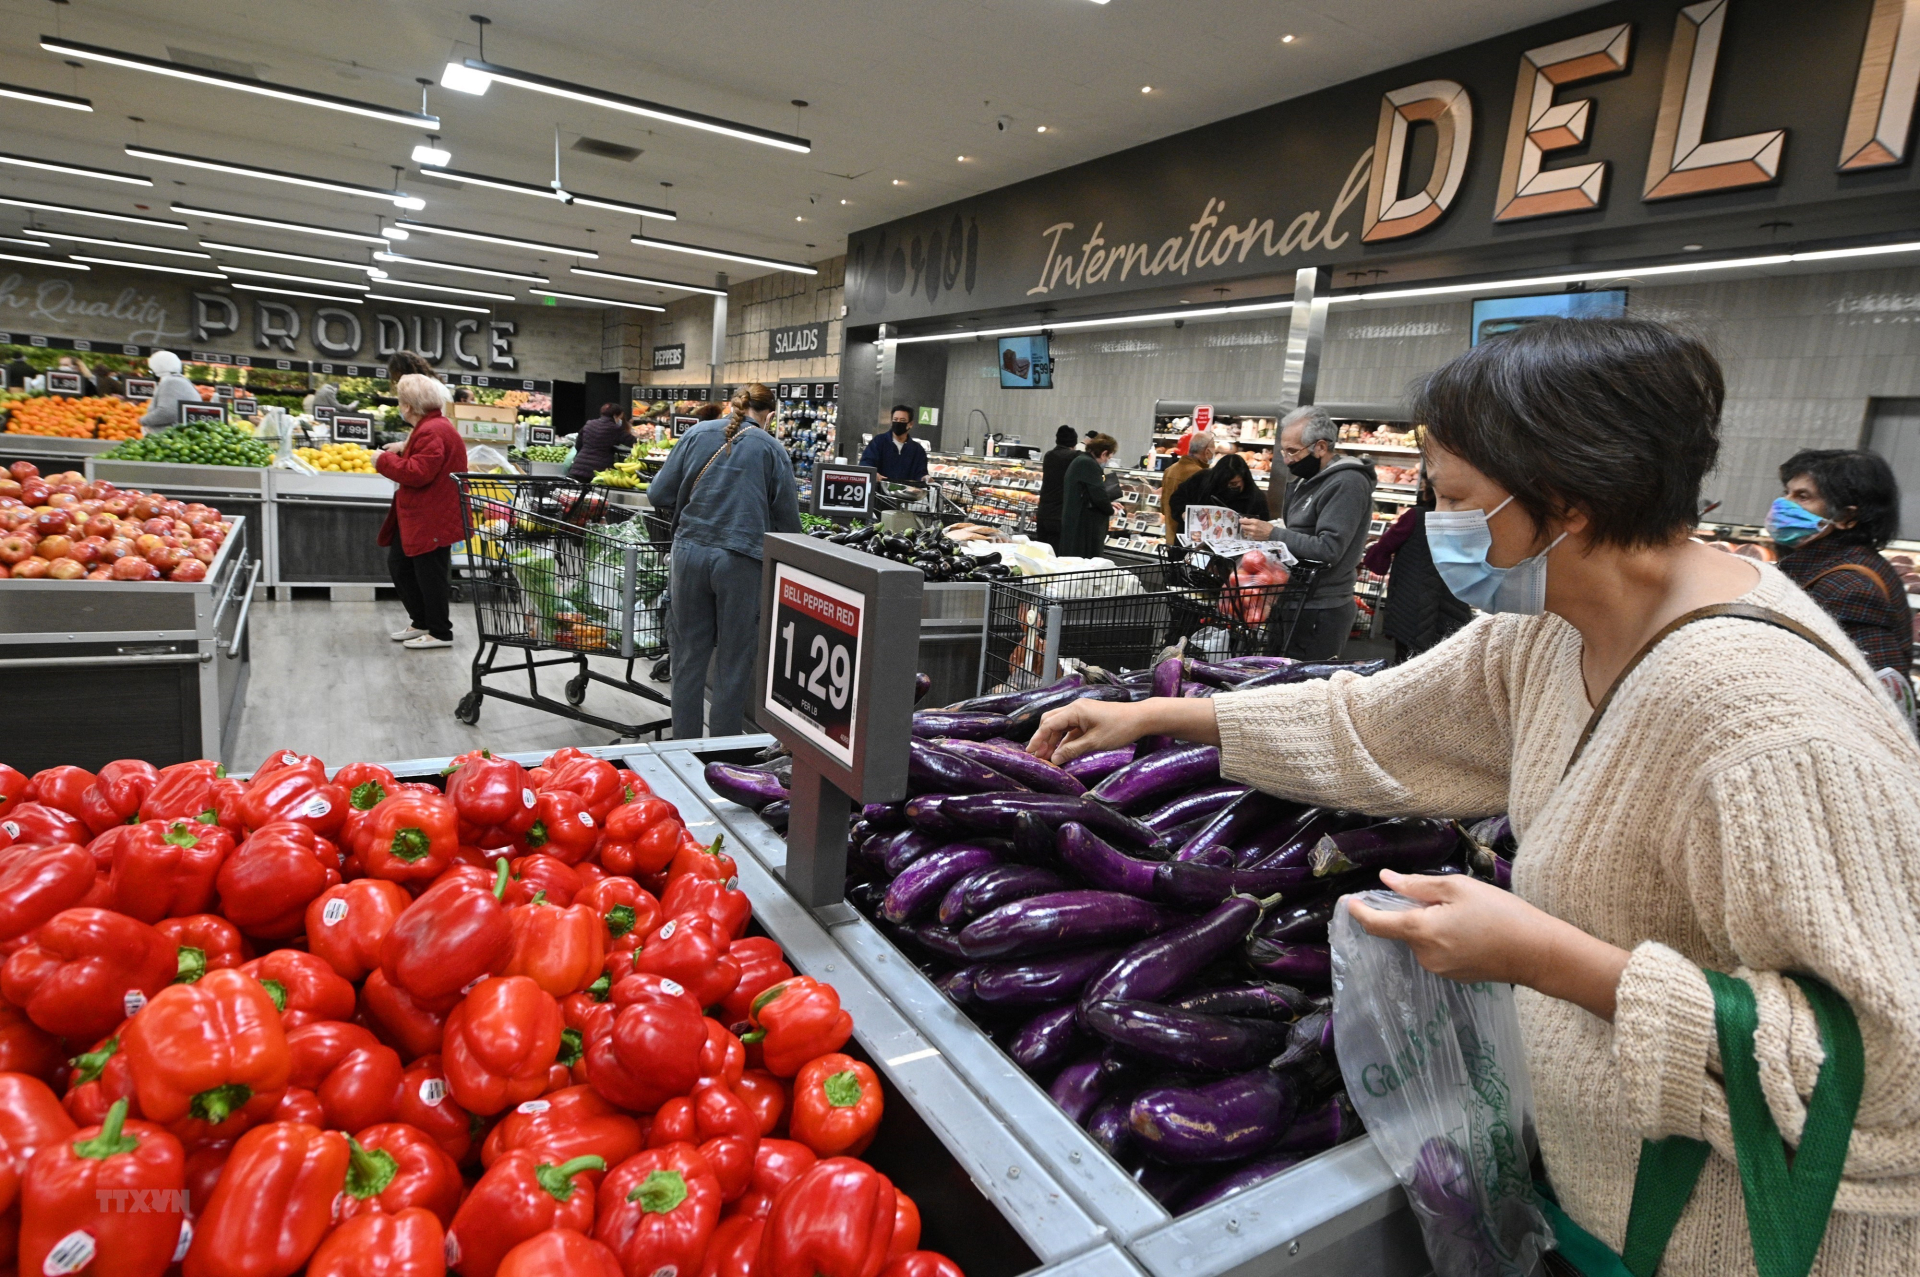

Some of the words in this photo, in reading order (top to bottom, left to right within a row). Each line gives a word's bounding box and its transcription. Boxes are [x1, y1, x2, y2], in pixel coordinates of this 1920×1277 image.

[1027, 145, 1375, 295] International
[1362, 0, 1920, 243] DELI
[29, 279, 191, 344] Quality
[193, 290, 516, 371] PRODUCE
[774, 328, 819, 354] SALADS
[654, 348, 682, 366] PEPPERS
[921, 410, 929, 422] A
[535, 432, 550, 441] 99¢
[827, 483, 865, 501] 1.29
[783, 583, 802, 604] BELL
[803, 592, 835, 618] PEPPER
[836, 606, 855, 627] RED
[782, 621, 852, 710] 1.29
[801, 699, 811, 713] PER
[811, 705, 818, 716] LB
[1361, 1001, 1449, 1098] Garden
